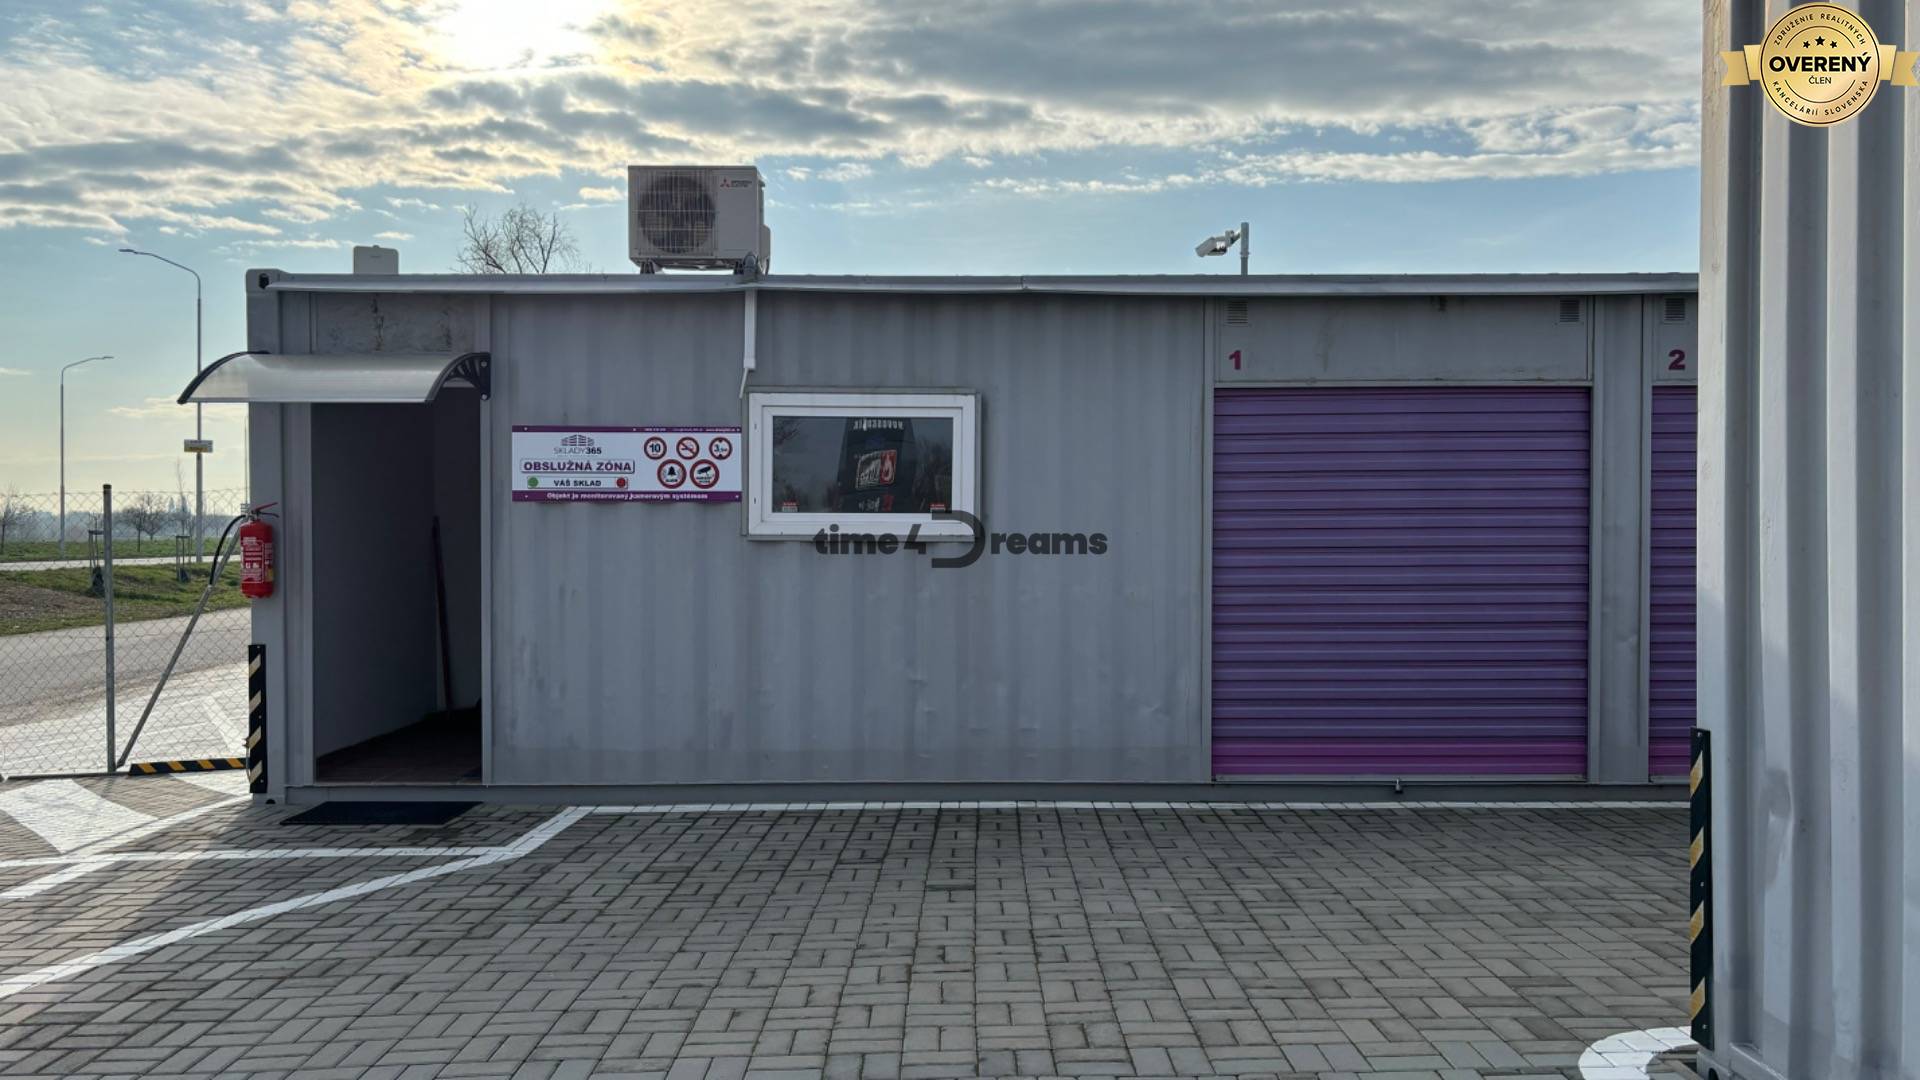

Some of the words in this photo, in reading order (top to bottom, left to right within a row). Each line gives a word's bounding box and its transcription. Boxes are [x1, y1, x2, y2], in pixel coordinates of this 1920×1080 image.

[1228, 350, 1241, 370] 1
[1668, 349, 1686, 371] 2
[553, 446, 602, 455] SKLADY365
[649, 443, 661, 453] 10
[523, 460, 593, 471] OBSLUŽNÁ
[596, 460, 632, 471] ZÓNA
[553, 479, 571, 487] VÁŠ
